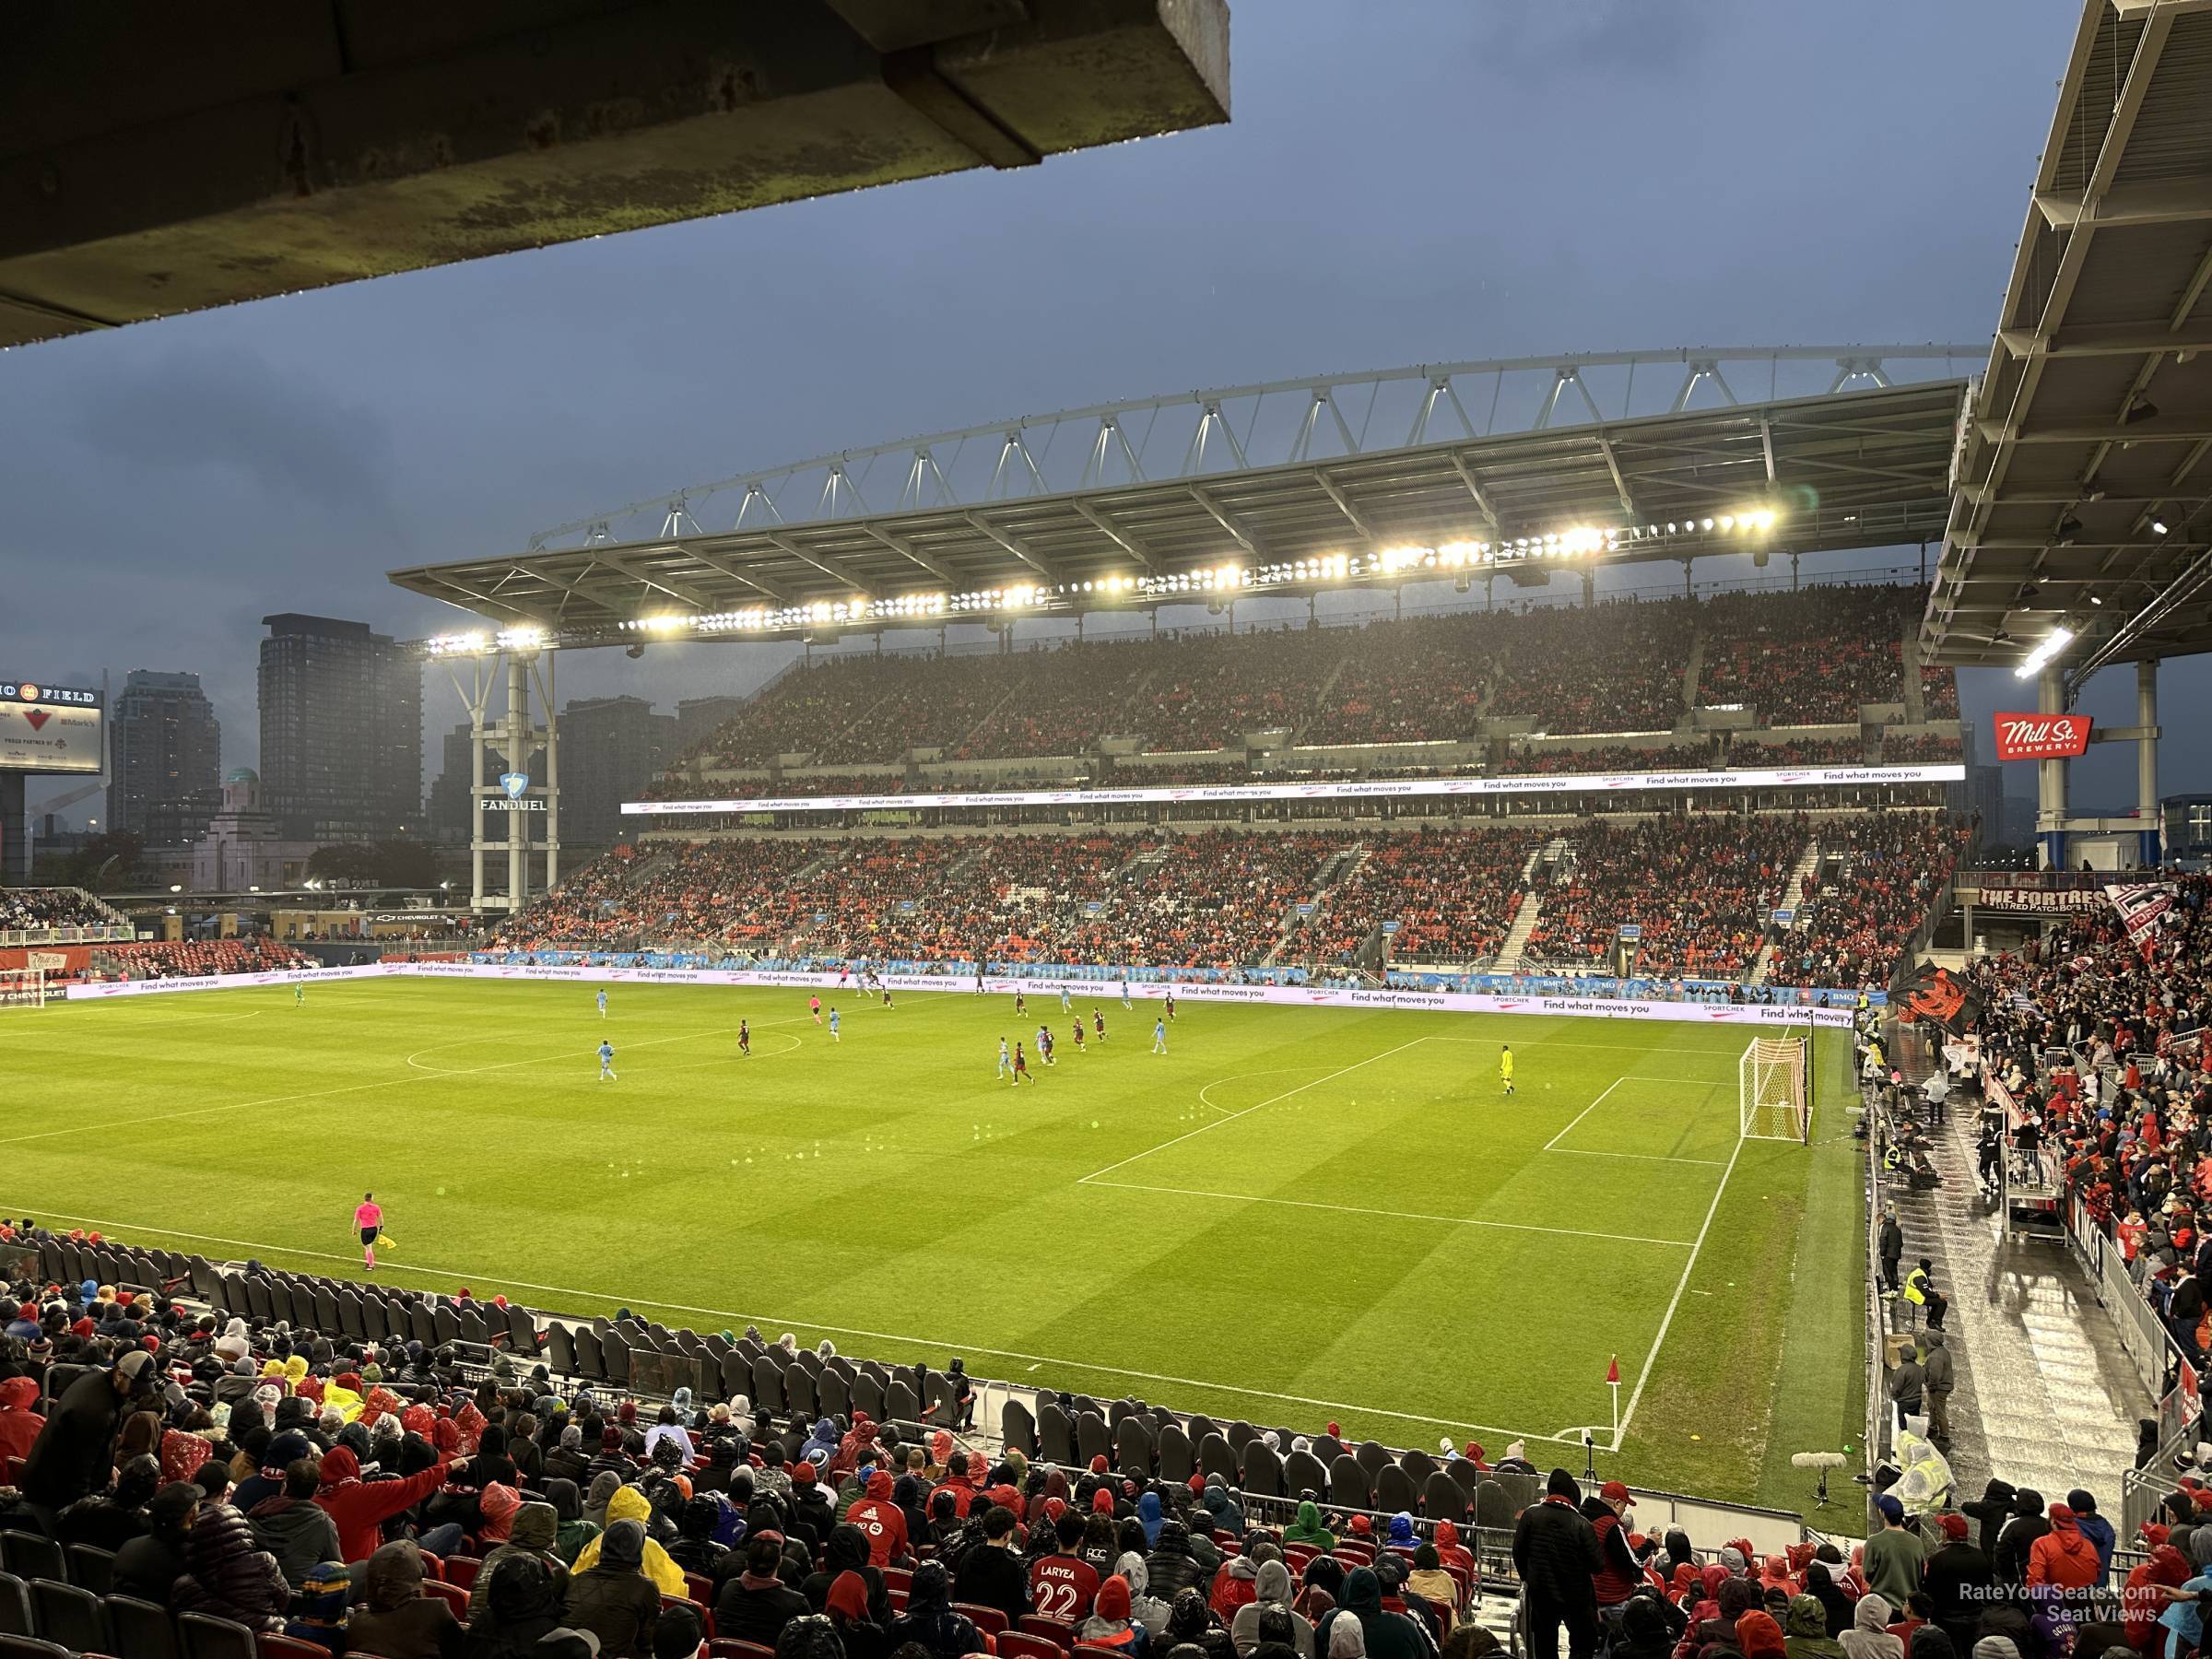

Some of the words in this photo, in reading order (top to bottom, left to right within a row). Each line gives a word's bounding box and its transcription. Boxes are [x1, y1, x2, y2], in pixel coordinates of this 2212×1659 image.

[42, 688, 95, 702] FIELD
[2001, 720, 2048, 745] Mill
[2051, 719, 2077, 742] St.
[2007, 743, 2065, 754] BREWERY
[480, 800, 547, 811] FANDUEL
[1981, 887, 2014, 906] THE
[2018, 889, 2108, 910] FORTRES
[2009, 902, 2029, 911] RED
[2030, 902, 2059, 912] PATCH
[1352, 993, 1370, 1001] Find
[1373, 994, 1395, 1002] what
[1832, 992, 1854, 1002] BMO
[1544, 999, 1564, 1008] Find
[1568, 1000, 1593, 1009] what
[1630, 1006, 1649, 1014] you
[1761, 1008, 1784, 1018] Find
[1789, 1009, 1810, 1018] wha
[1041, 1565, 1075, 1581] LARYEA
[1036, 1581, 1077, 1623] 22
